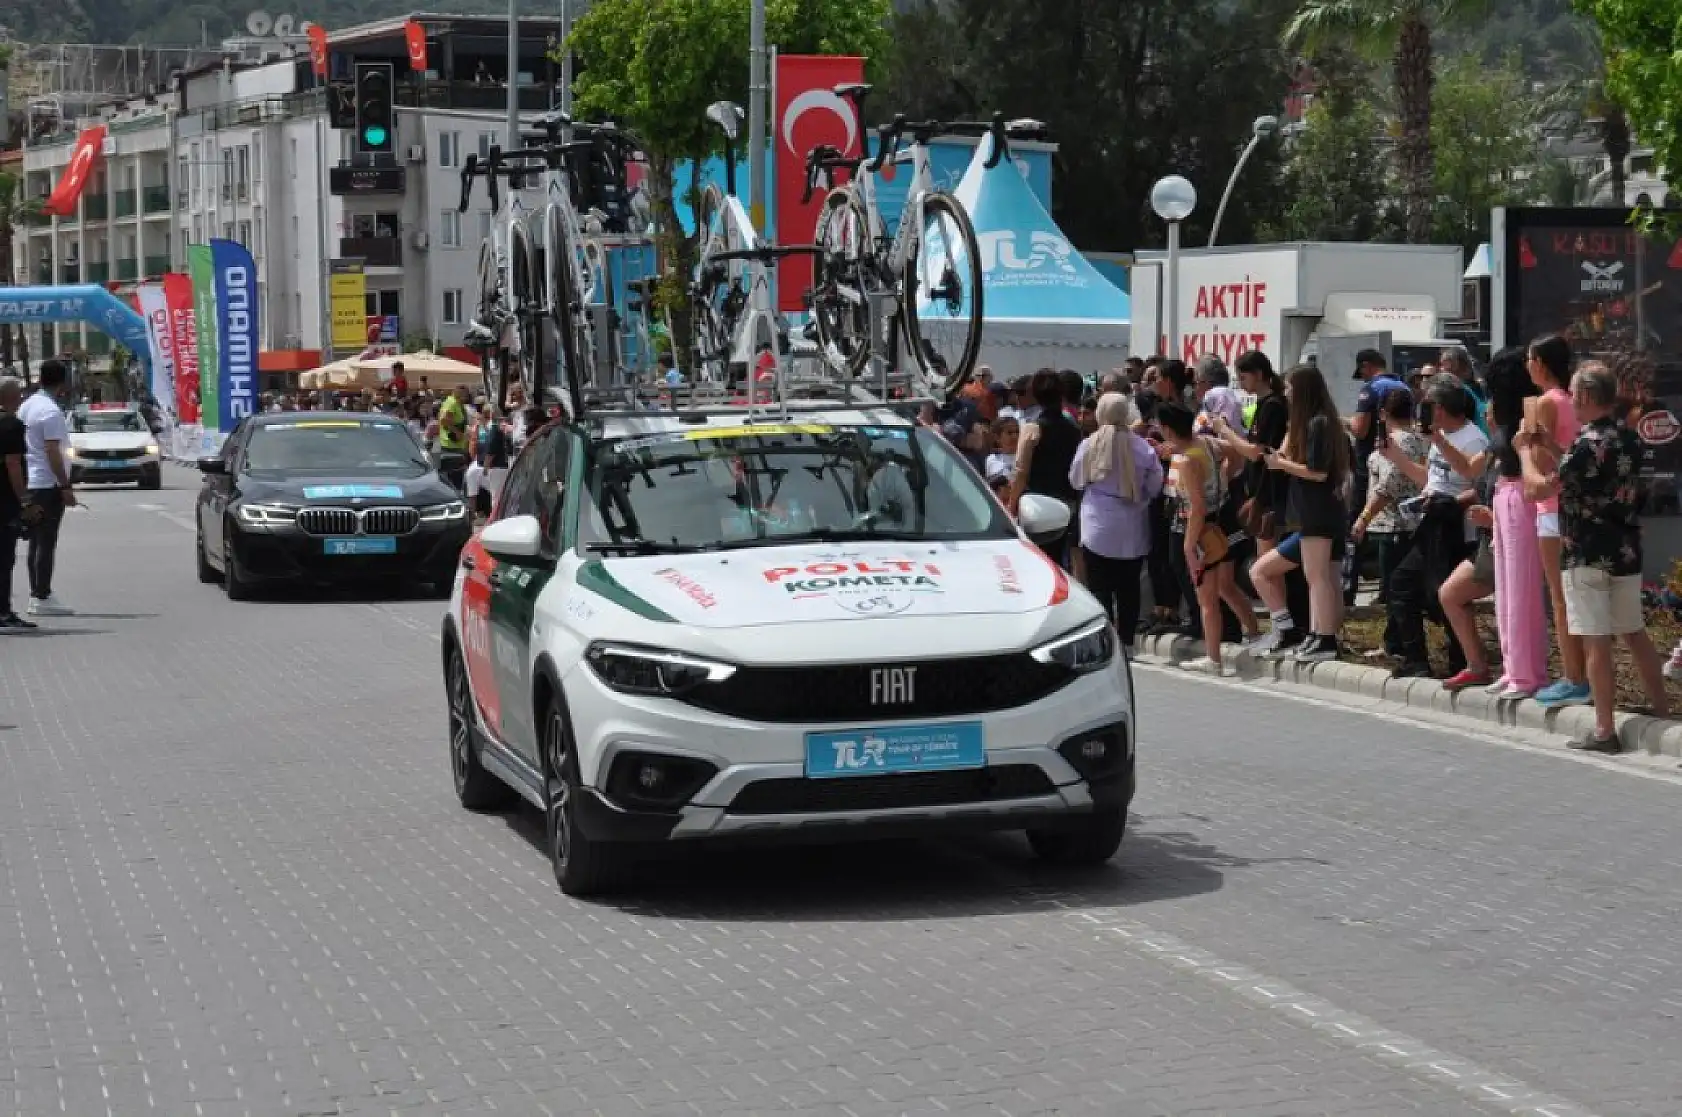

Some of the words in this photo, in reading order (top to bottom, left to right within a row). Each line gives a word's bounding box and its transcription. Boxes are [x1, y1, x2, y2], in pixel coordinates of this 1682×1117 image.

[1194, 274, 1266, 318] AKTİF
[785, 575, 941, 593] KOMETA
[871, 665, 918, 704] FIAT
